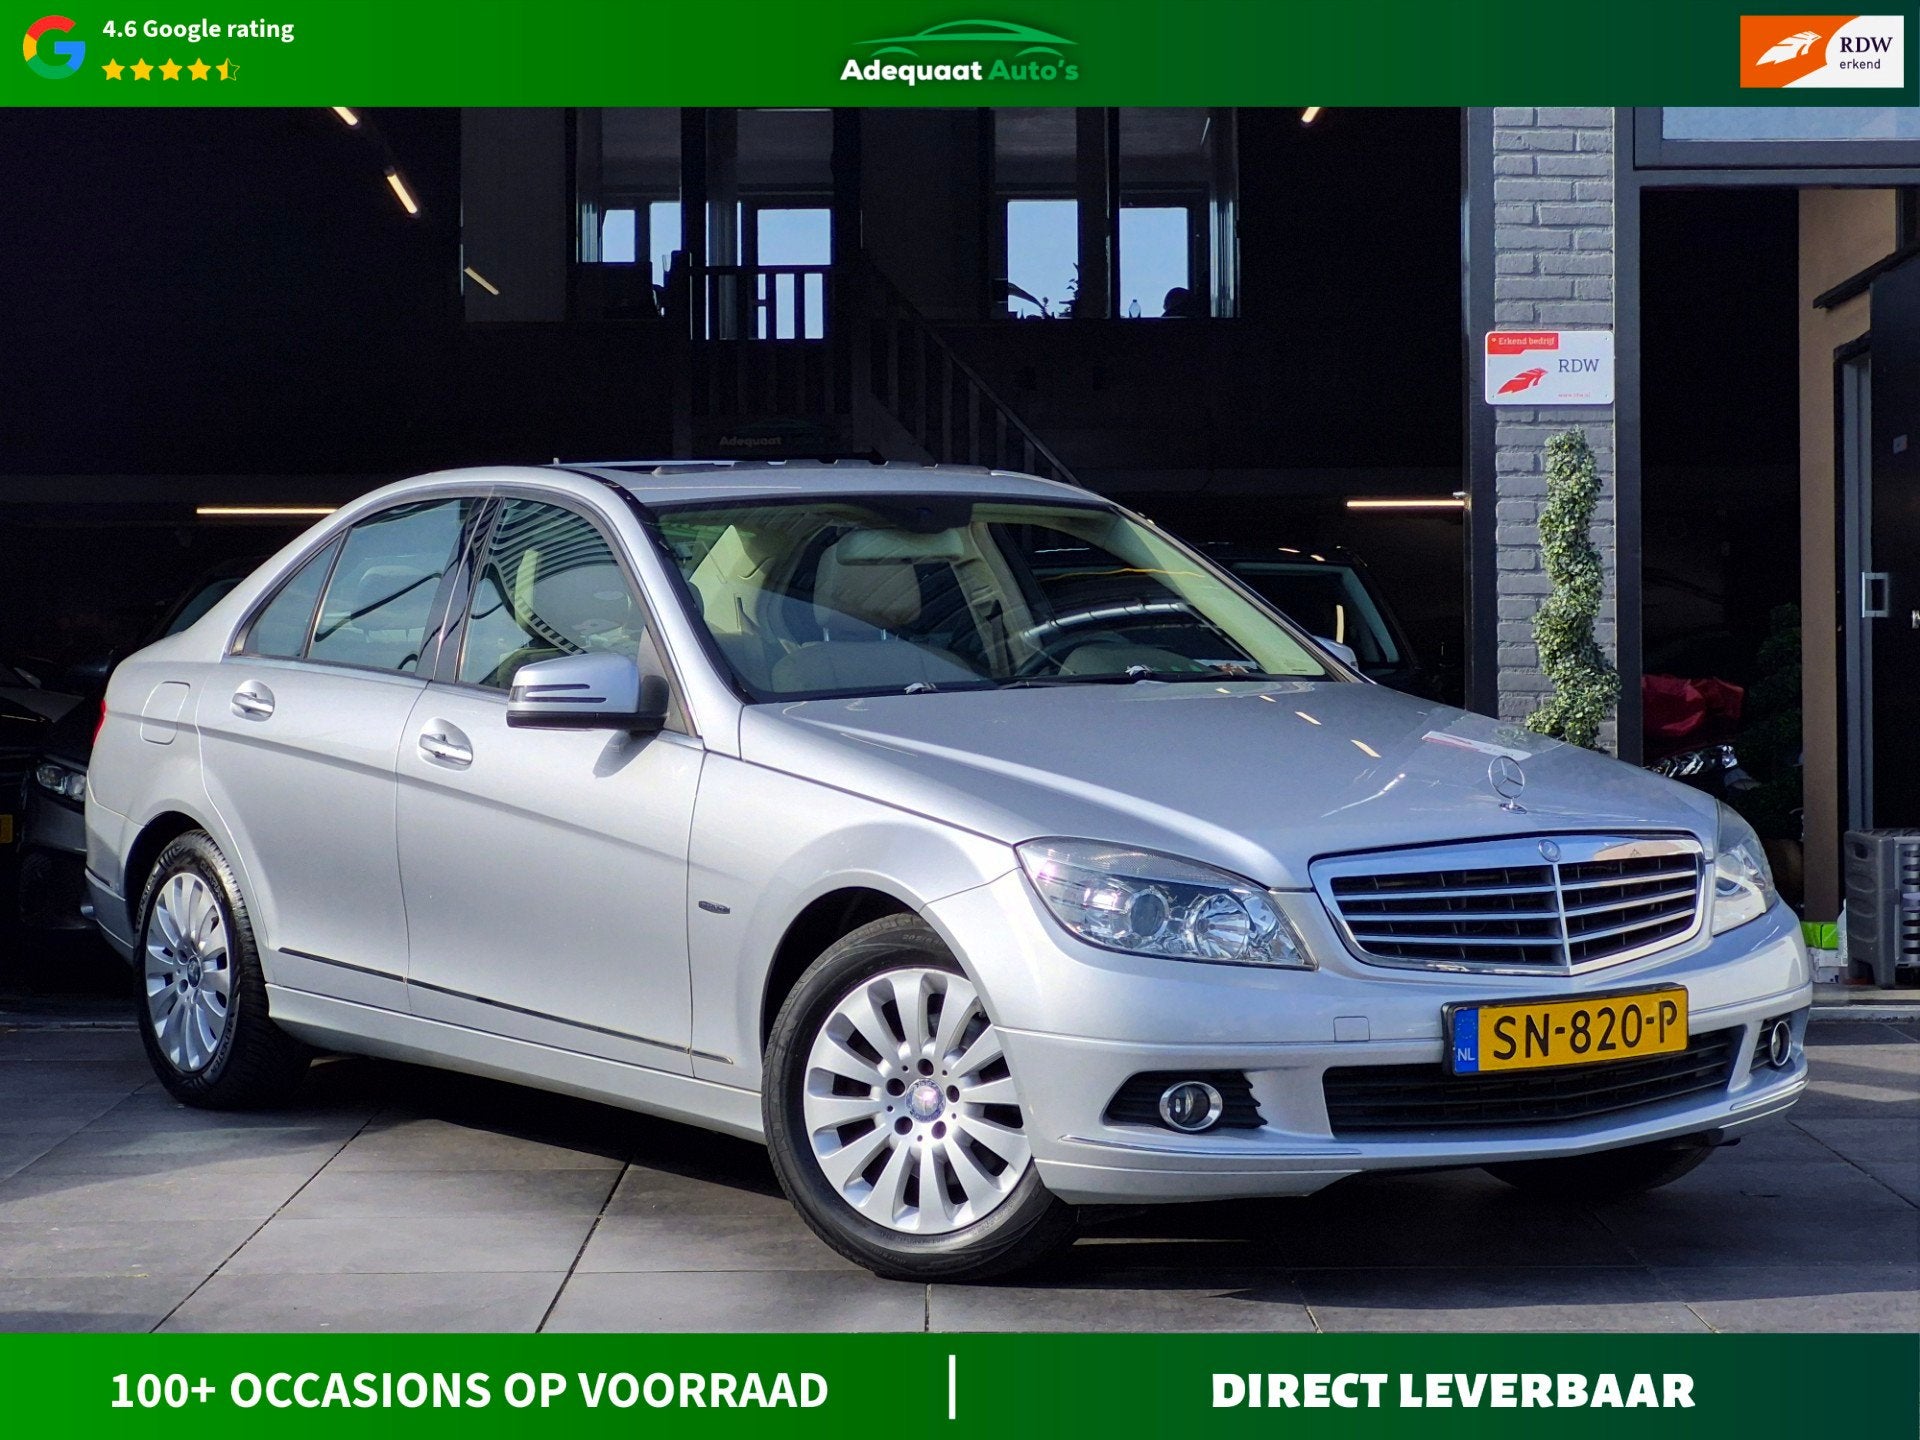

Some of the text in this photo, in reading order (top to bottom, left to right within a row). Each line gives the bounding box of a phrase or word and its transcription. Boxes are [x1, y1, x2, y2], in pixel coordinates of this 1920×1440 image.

[1498, 337, 1555, 346] Erkend bedrijf
[1558, 358, 1600, 373] RDW
[1493, 1000, 1678, 1060] SN-820-P
[1457, 1047, 1476, 1061] NL
